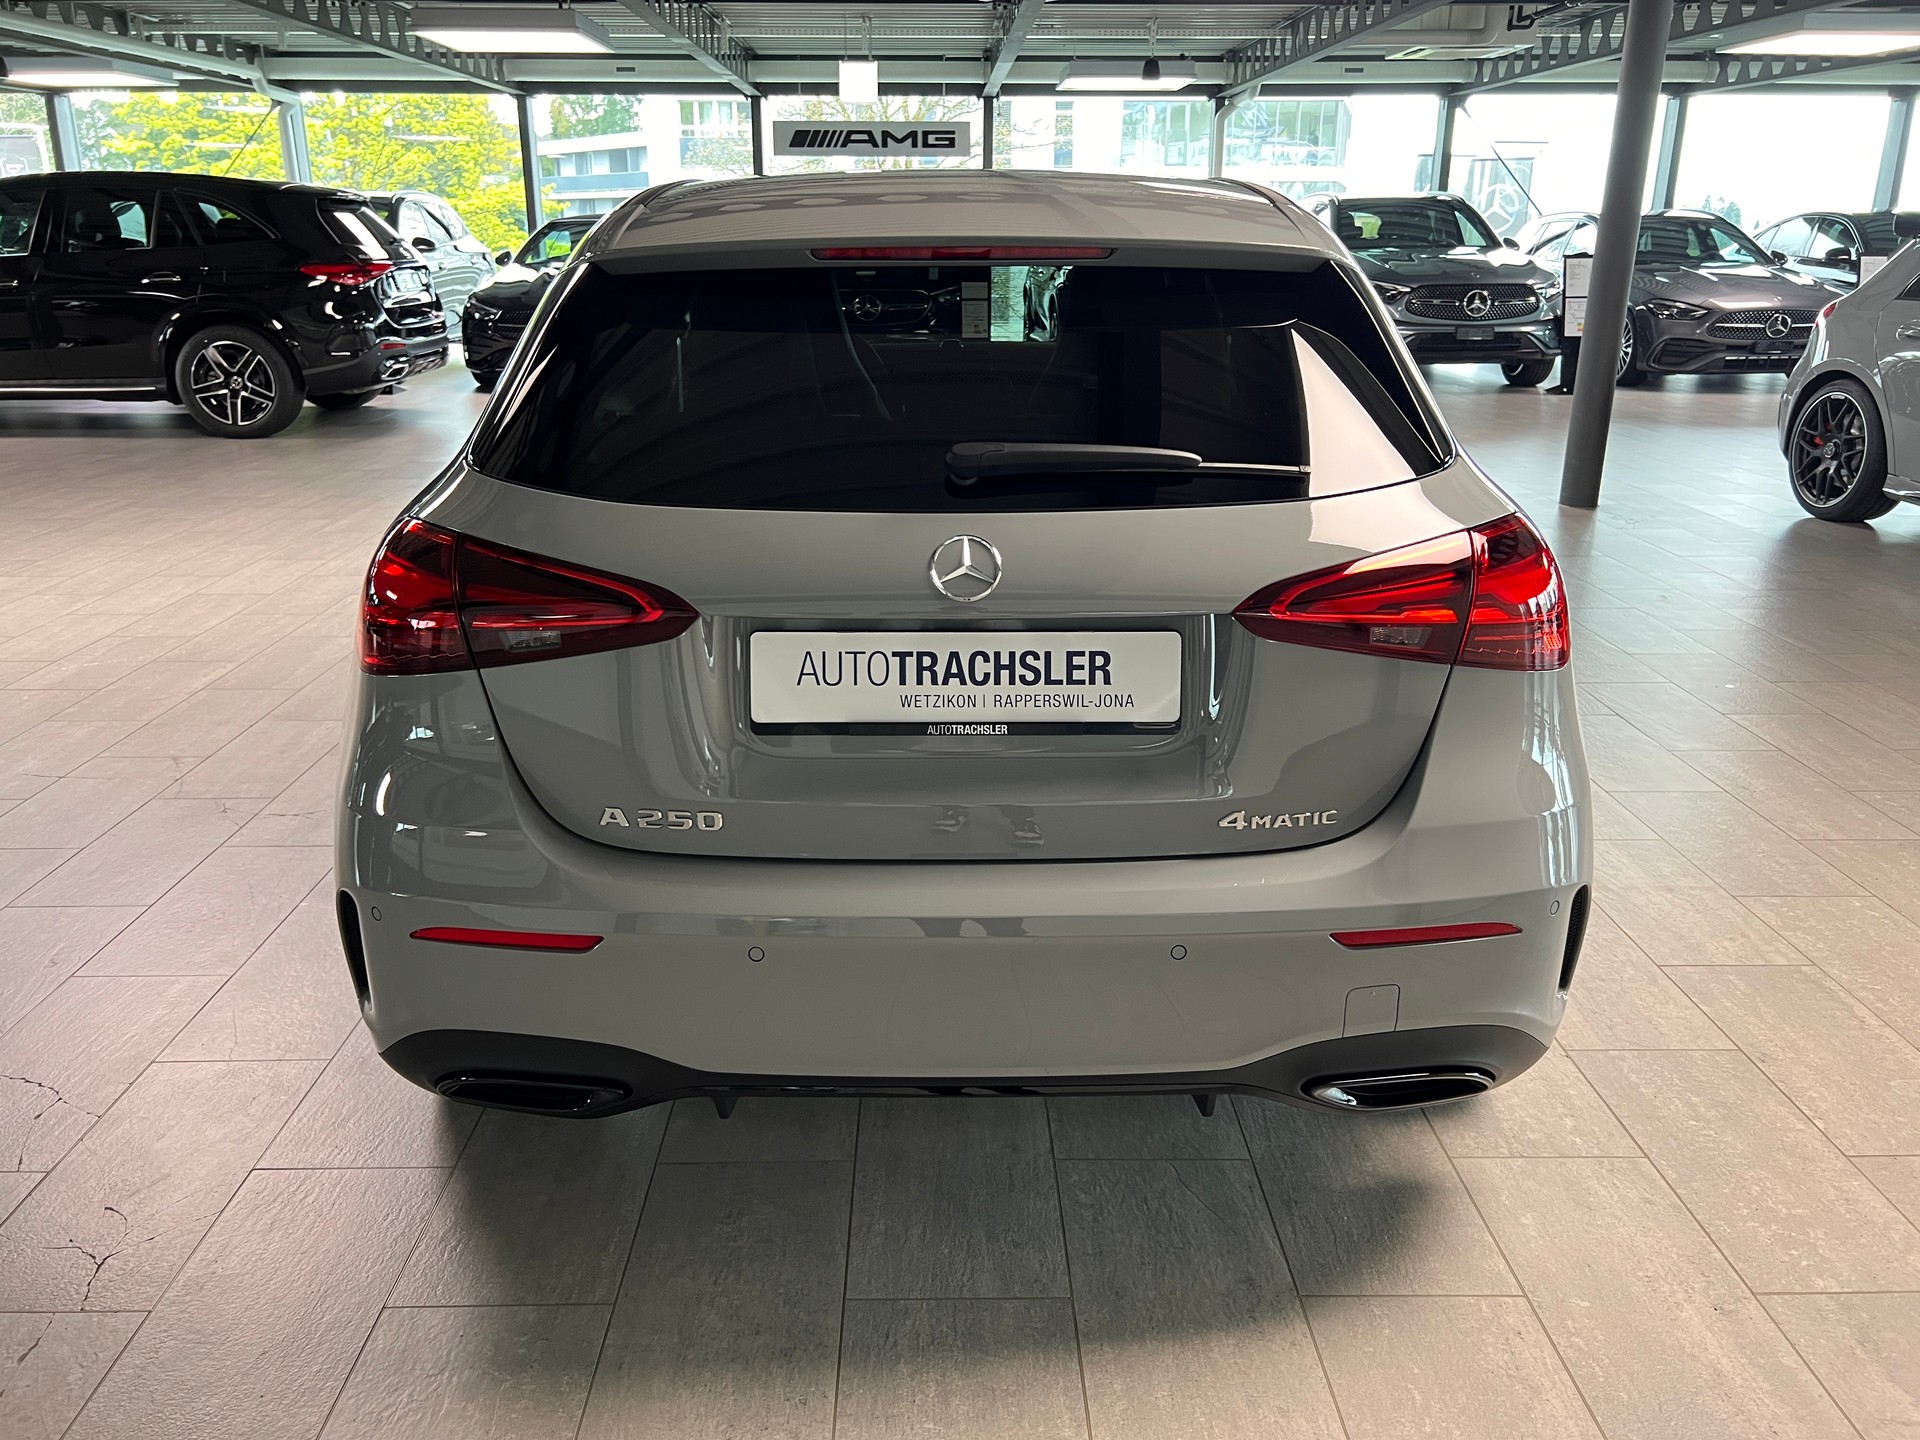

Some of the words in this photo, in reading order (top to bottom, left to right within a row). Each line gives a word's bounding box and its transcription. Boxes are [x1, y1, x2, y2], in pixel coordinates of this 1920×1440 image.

[839, 129, 956, 149] AMG
[796, 650, 1113, 687] AUTOTRACHSLER
[899, 693, 977, 709] WETZIKON
[993, 693, 1136, 709] RAPPERSWIL-JONA
[926, 724, 1009, 736] AUTOTRACHSLER
[600, 806, 630, 828] A
[637, 808, 724, 832] 250
[1218, 809, 1339, 831] 4MATIC
